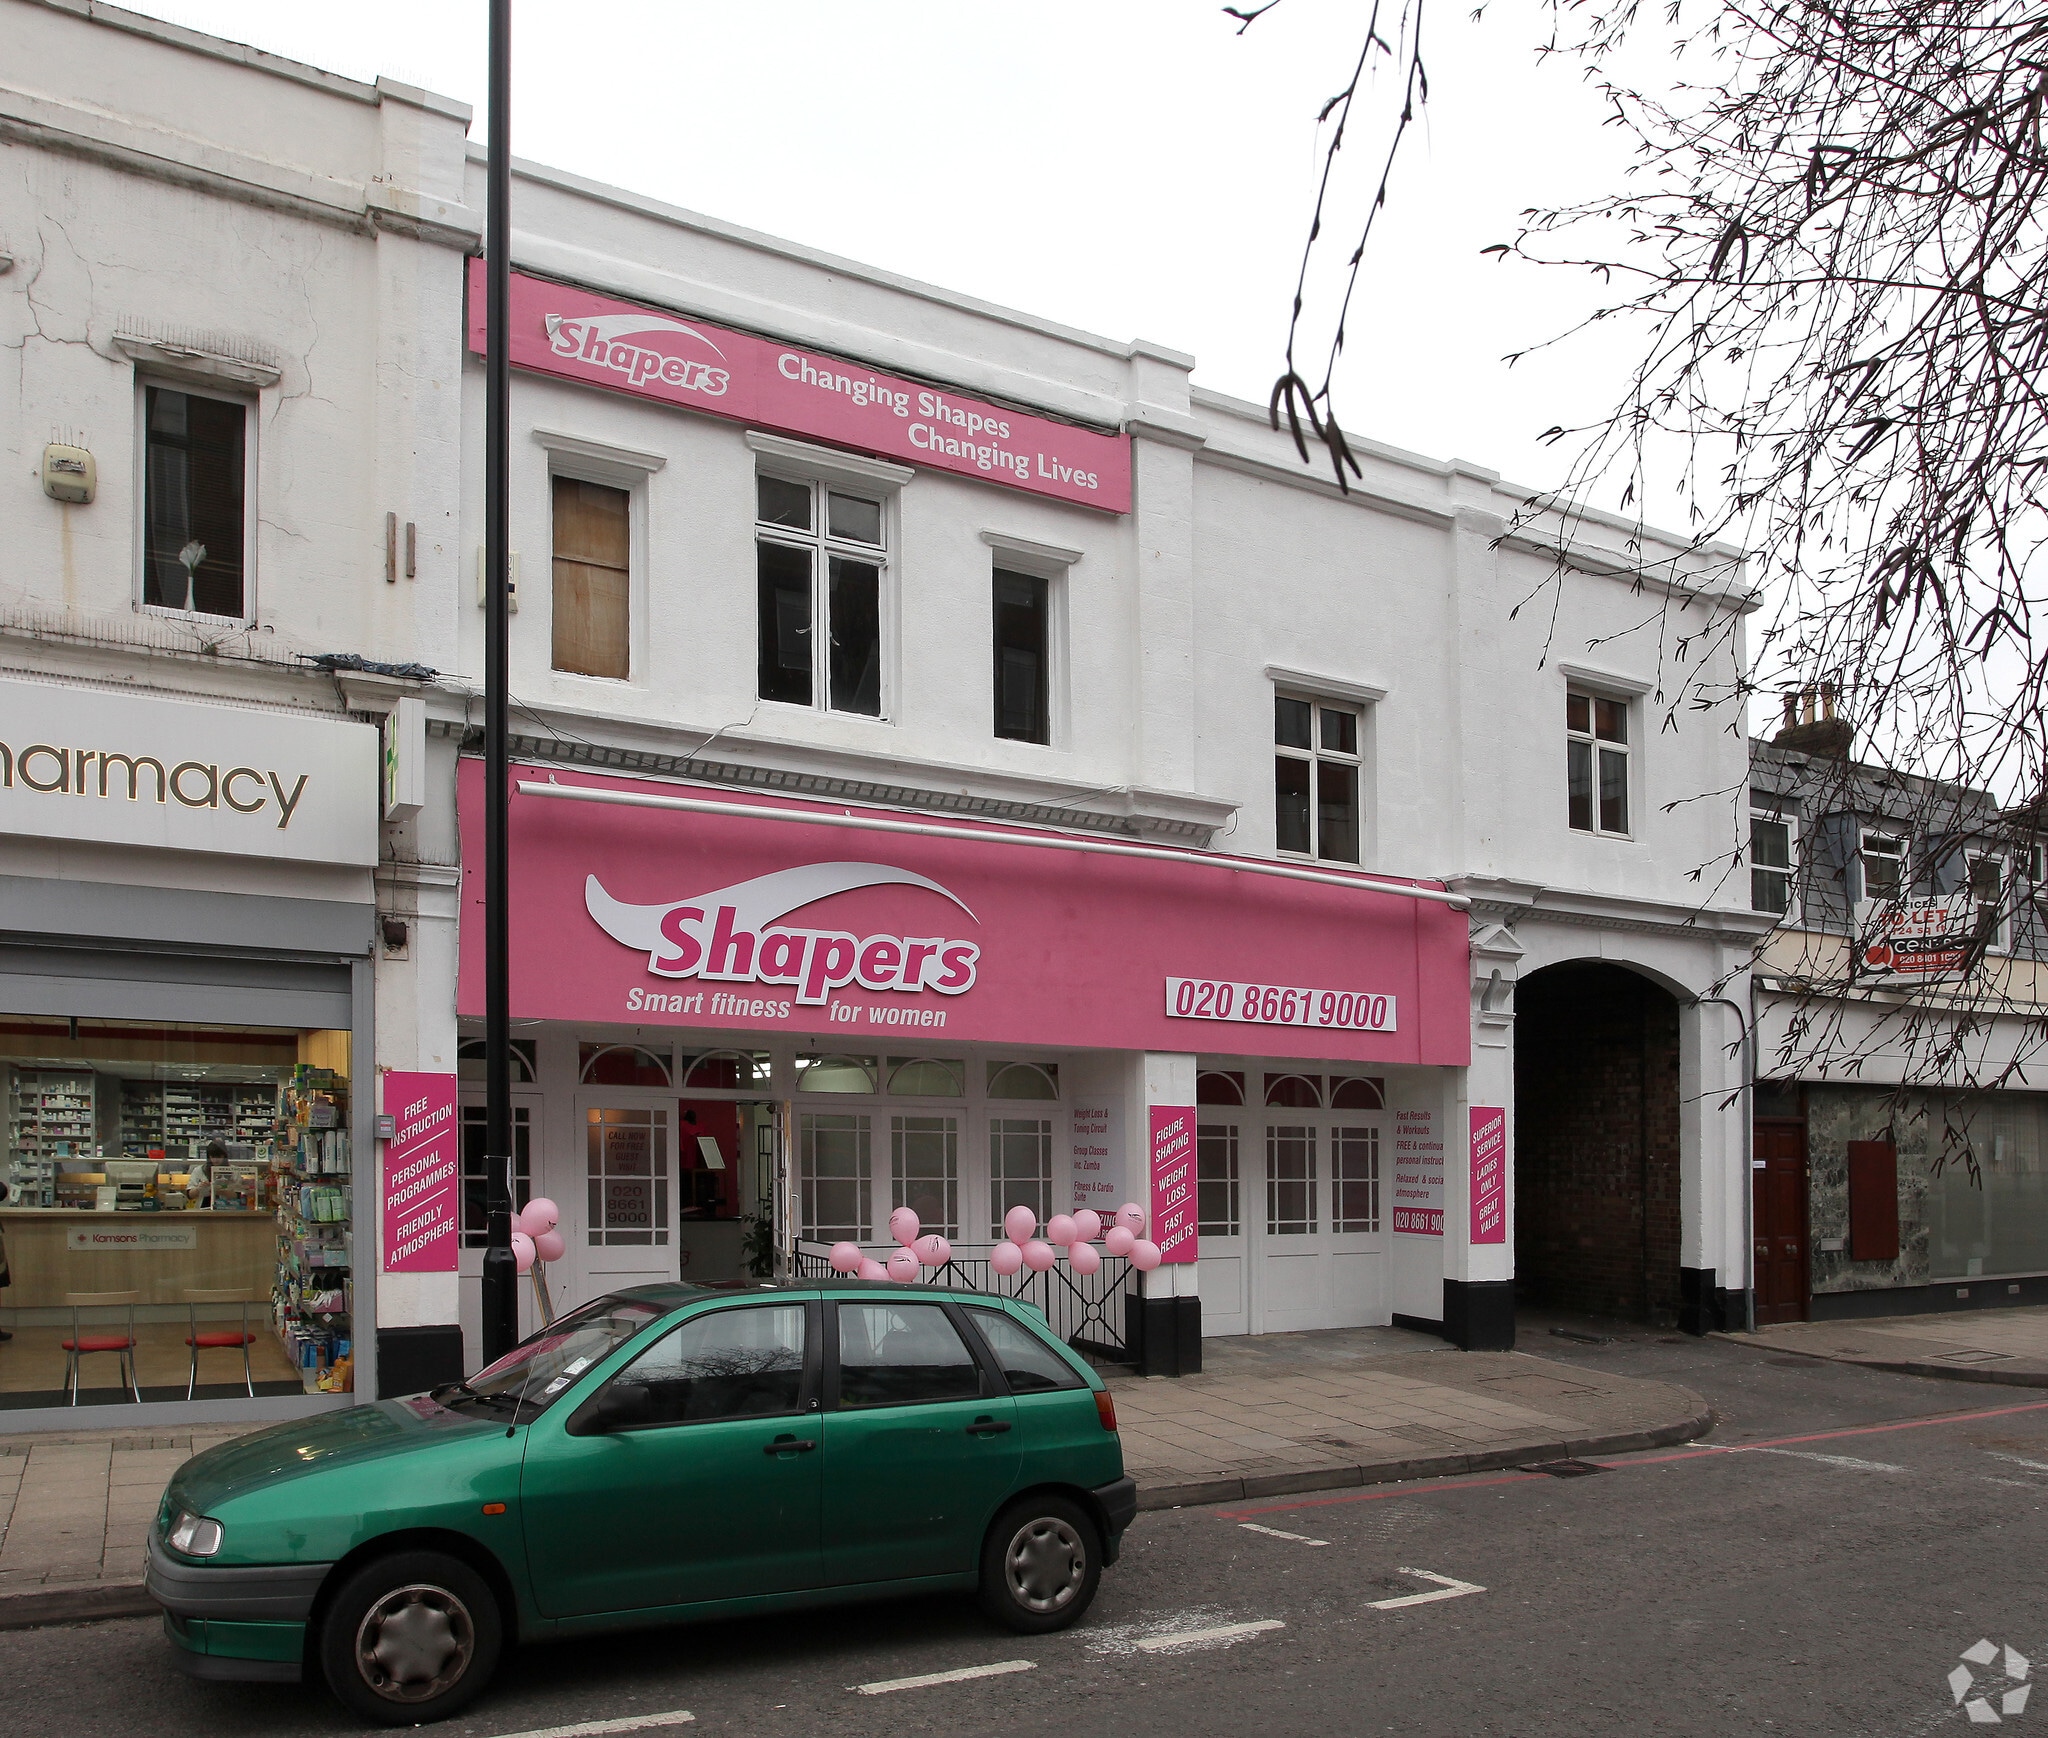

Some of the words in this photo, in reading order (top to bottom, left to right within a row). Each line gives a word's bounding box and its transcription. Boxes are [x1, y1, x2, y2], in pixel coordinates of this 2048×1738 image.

[551, 321, 728, 396] Shapers
[778, 354, 908, 417] Changing
[917, 393, 1011, 439] Shapes
[908, 422, 1029, 479] Changing
[1037, 454, 1099, 490] Lives
[1912, 909, 1948, 924] LET
[656, 906, 975, 998] Shapers
[626, 988, 703, 1014] Smart
[710, 993, 790, 1018] fitness
[830, 1001, 862, 1023] for
[869, 1006, 947, 1028] women
[1176, 981, 1234, 1018] 020
[1242, 986, 1312, 1023] 8661
[1319, 992, 1387, 1028] 9000
[404, 1096, 428, 1121] FREE
[1091, 1109, 1103, 1118] Loss
[1396, 1111, 1409, 1120] Fast
[1410, 1111, 1431, 1120] Results
[390, 1103, 452, 1149] INSTRUCTION
[608, 1131, 626, 1140] CALL
[1156, 1117, 1184, 1145] FIGURE
[1403, 1126, 1430, 1135] Workouts
[1473, 1114, 1502, 1144] SUPERIOR
[1073, 1145, 1088, 1157] Group
[1089, 1145, 1108, 1156] Classes
[1155, 1132, 1189, 1163] SHAPING
[1396, 1140, 1411, 1150] FREE
[1476, 1131, 1501, 1158] SERVICE
[392, 1150, 441, 1188] PERSONAL
[1083, 1160, 1100, 1170] Zumba
[1396, 1155, 1421, 1166] personal
[1476, 1158, 1498, 1181] LADIES
[387, 1161, 454, 1211] PROGRAMMES
[1073, 1181, 1091, 1191] Fitness
[1097, 1182, 1114, 1193] Cardio
[1158, 1163, 1188, 1192] WEIGHT
[1396, 1174, 1419, 1184] Relaxed
[1480, 1174, 1497, 1194] ONLY
[612, 1186, 642, 1197] 020
[1073, 1192, 1087, 1202] Suite
[1166, 1183, 1186, 1206] LOSS
[1396, 1189, 1430, 1199] atmosphere
[607, 1200, 645, 1210] 8661
[1479, 1198, 1499, 1220] GREAT
[396, 1204, 443, 1242] FRIENDLY
[607, 1213, 648, 1223] 9000
[1164, 1211, 1184, 1233] FAST
[1396, 1211, 1409, 1228] 020
[1410, 1212, 1429, 1230] 8661
[1480, 1212, 1500, 1234] VALUE
[92, 1234, 137, 1243] Kamsons
[139, 1234, 189, 1244] Pharmacy
[391, 1217, 454, 1265] ATMOSPHERE
[1160, 1222, 1194, 1255] RESULTS
